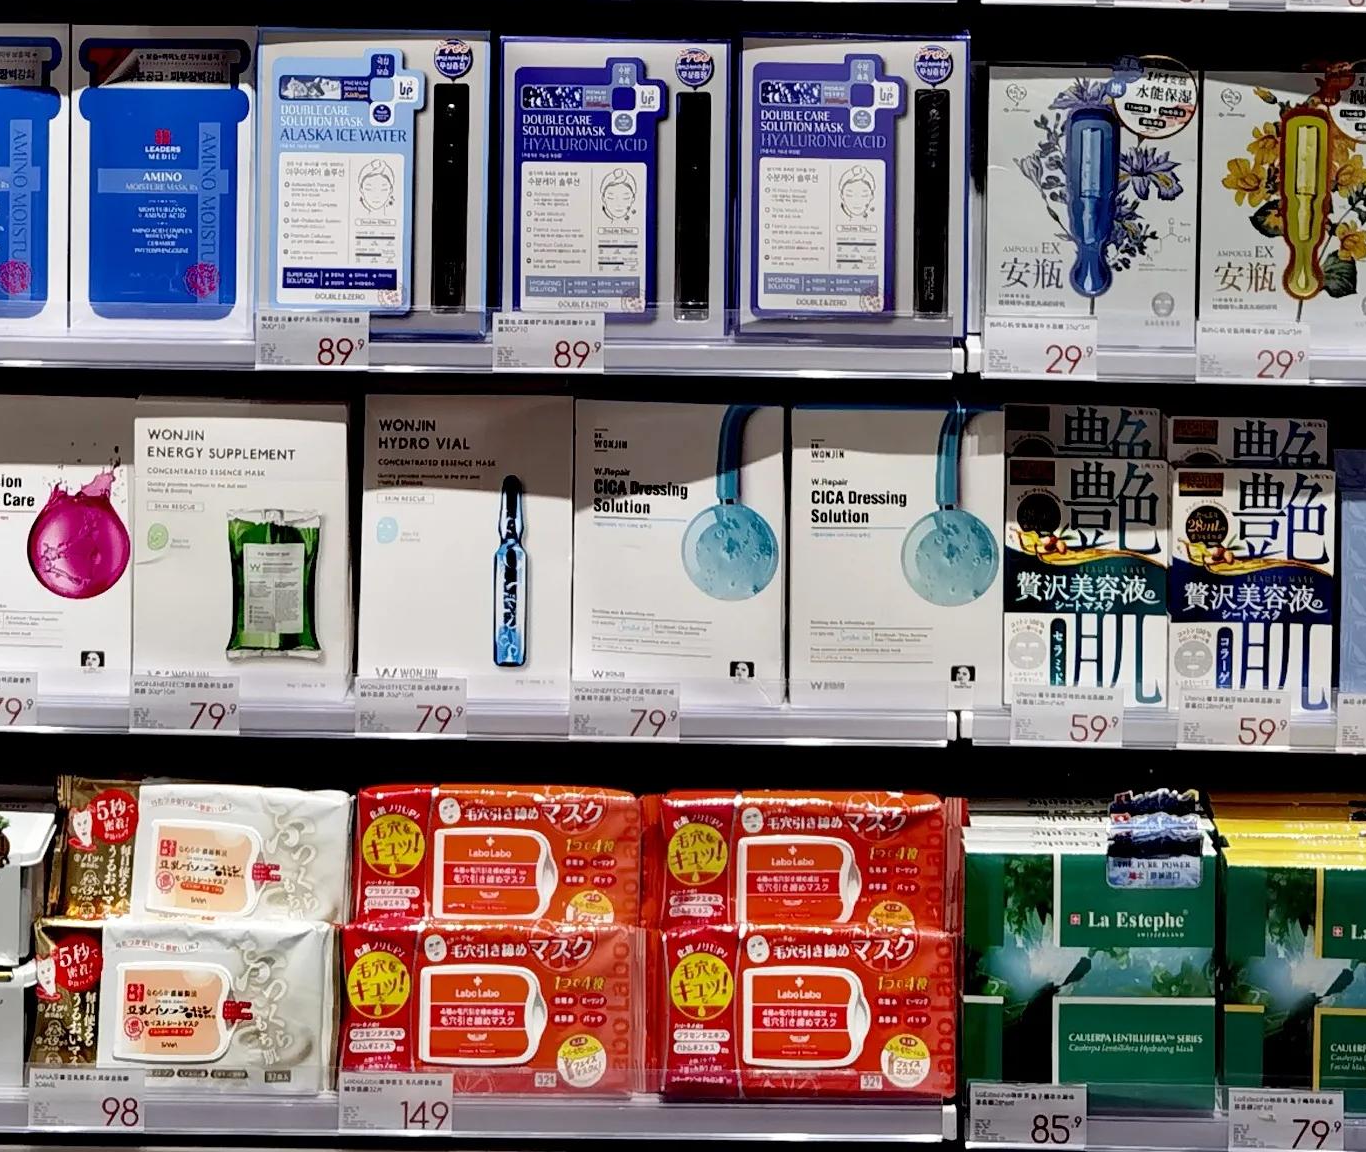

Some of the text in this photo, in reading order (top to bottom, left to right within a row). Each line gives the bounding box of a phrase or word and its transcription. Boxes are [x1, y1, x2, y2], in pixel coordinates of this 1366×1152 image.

[1136, 87, 1193, 103] 水能保湿
[761, 111, 830, 121] DOUBLE CARE
[280, 129, 406, 142] ALASKA ICE WATER
[761, 121, 845, 133] SOLUTION MASK
[523, 138, 648, 152] HYALURONIC ACID
[1213, 262, 1278, 293] 安瓶
[379, 419, 436, 434] WONJIN
[379, 436, 470, 450] HYDRO VIAL
[147, 445, 296, 462] ENERGY SUPPLEMENT
[4, 492, 36, 507] Care
[593, 497, 650, 516] Solution
[811, 489, 907, 510] CICA Dressing
[811, 507, 869, 524] Solution
[1184, 583, 1329, 613] 贅沢美容液の
[464, 802, 603, 826] 毛穴引き締め マスク
[1088, 912, 1185, 934] La Estephe
[772, 936, 914, 962] 毛穴引き締め マスク
[101, 1096, 140, 1127] 98
[399, 1101, 449, 1131] 149
